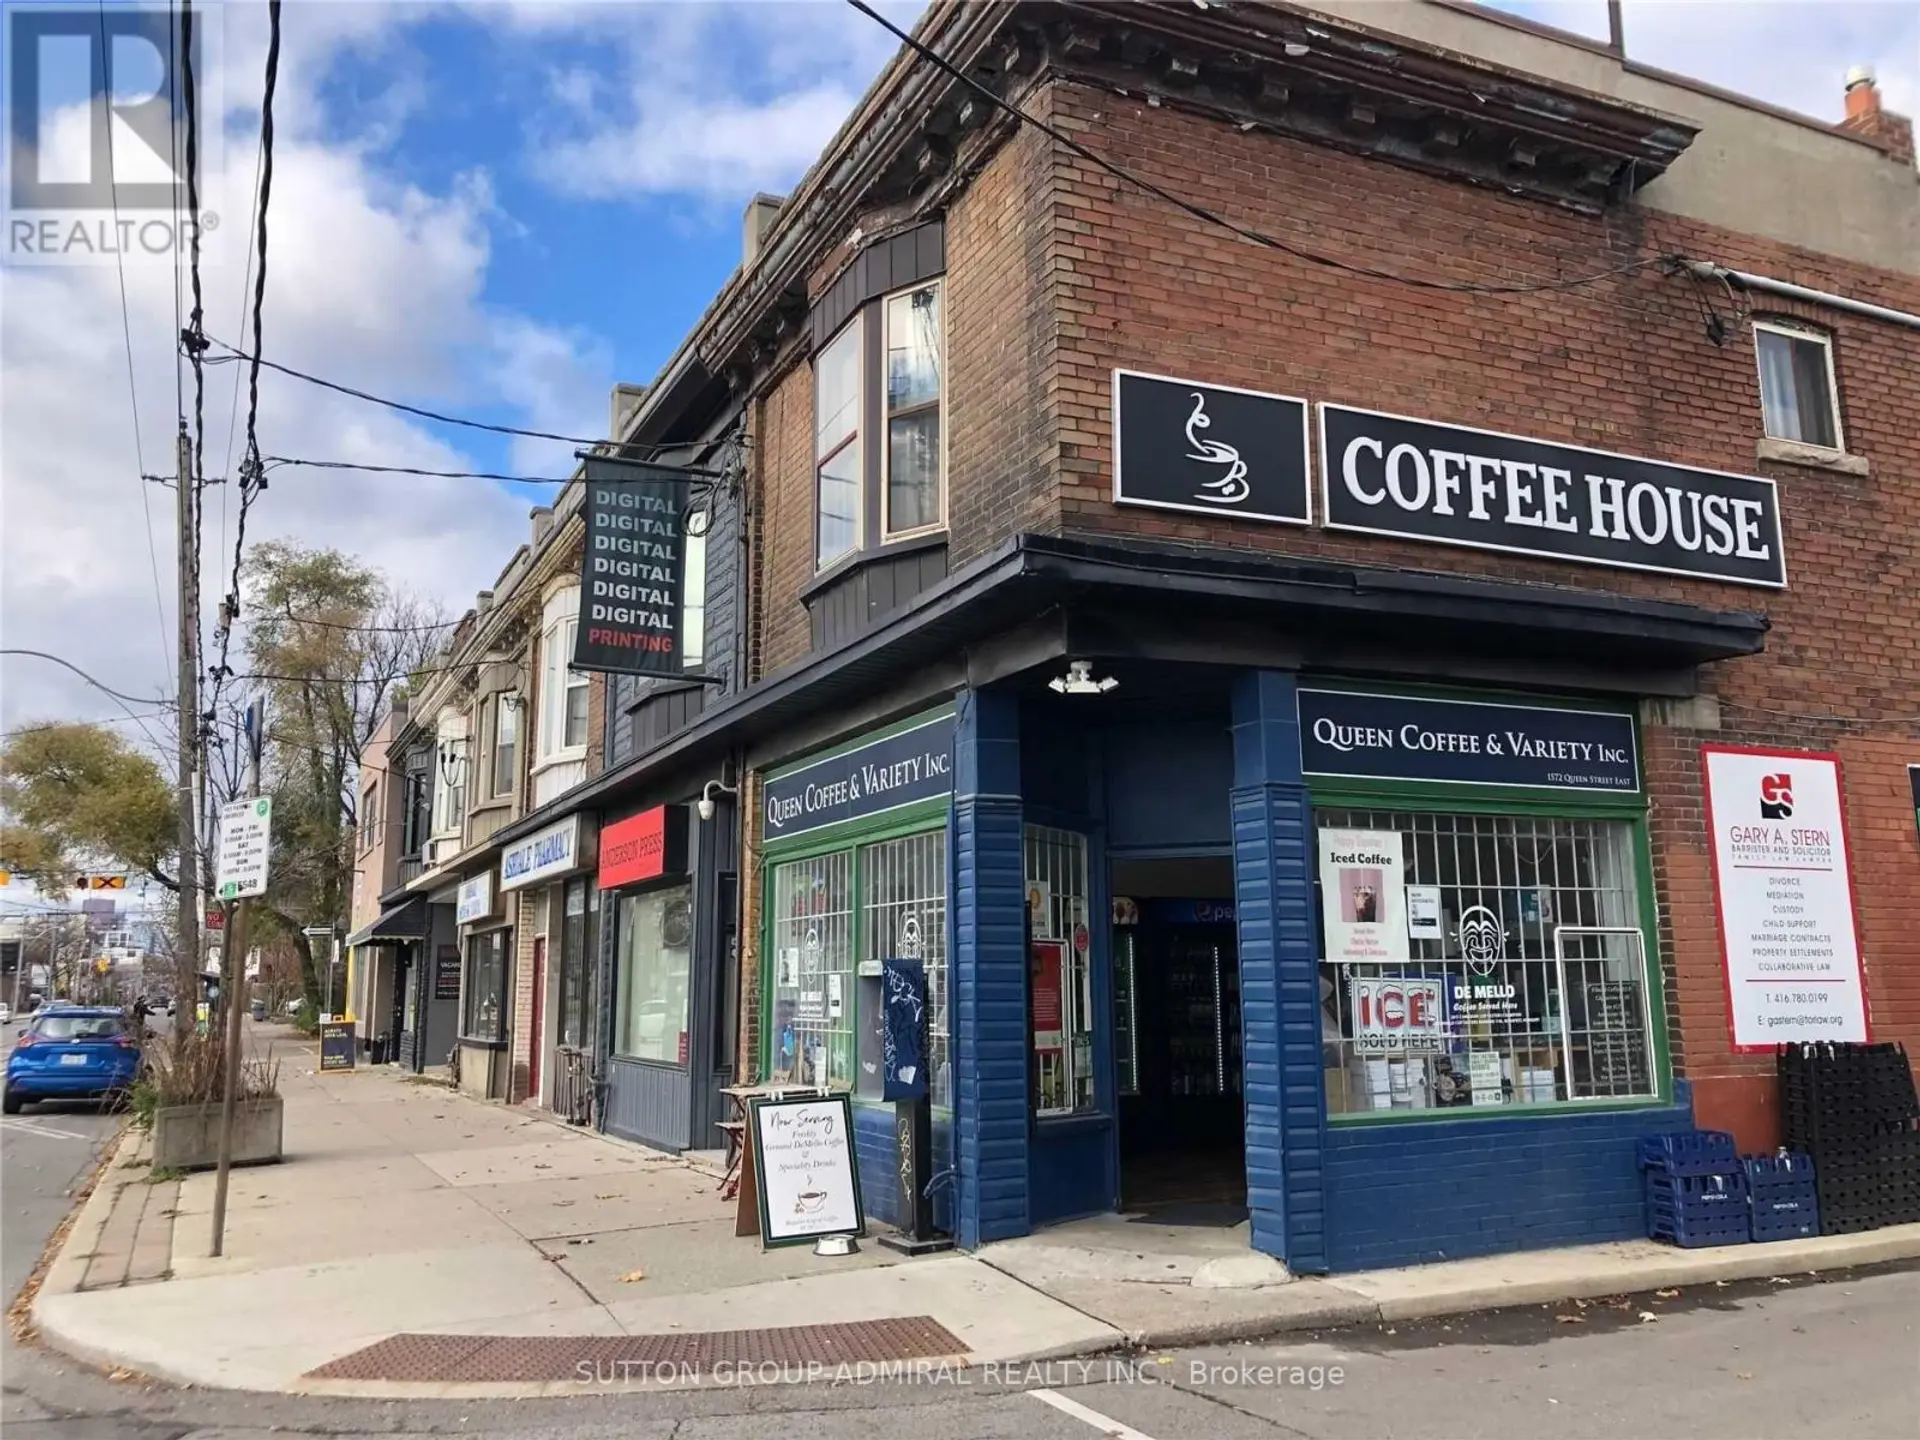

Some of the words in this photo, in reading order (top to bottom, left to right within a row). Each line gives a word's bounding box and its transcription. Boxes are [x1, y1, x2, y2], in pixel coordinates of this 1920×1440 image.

[596, 490, 678, 516] DIGITAL
[1342, 435, 1578, 533] COFFEE
[1584, 474, 1770, 561] HOUSE
[595, 512, 677, 538] DIGITAL
[595, 535, 676, 560] DIGITAL
[594, 558, 675, 583] DIGITAL
[593, 580, 674, 606] DIGITAL
[592, 604, 673, 629] DIGITAL
[589, 628, 673, 653] PRINTING
[1313, 718, 1394, 751] QUEEN
[1400, 724, 1480, 755] COFFEE
[1486, 735, 1504, 756] &
[1505, 731, 1593, 763] VARIETY
[1598, 744, 1629, 764] INC.
[1547, 772, 1564, 783] 1572
[1564, 774, 1587, 786] QUEEN
[1589, 775, 1613, 786] STREET
[1615, 776, 1631, 786] EAST
[767, 795, 803, 828] QUEEN
[805, 780, 848, 813] COFFEE
[849, 773, 860, 800] &
[861, 756, 922, 796] VARIETY
[638, 831, 663, 862] PRESS
[1730, 826, 1769, 845] GARY
[1773, 828, 1788, 845] A.
[1791, 829, 1830, 847] STERN
[1330, 852, 1355, 863] Iced
[1357, 853, 1392, 865] Coffee
[1731, 844, 1770, 854] BARRISTER
[1773, 846, 1790, 855] AND
[1792, 847, 1831, 857] SOLICITOR
[1769, 877, 1800, 886] DIVORCE
[1766, 891, 1804, 900] MEDIATION
[1772, 905, 1804, 914] CUSTODY
[1763, 919, 1784, 928] CHILD
[1787, 920, 1817, 929] SUPPORT
[1751, 934, 1787, 943] MARRIAGE
[1790, 934, 1831, 943] CONTRACTS
[1752, 948, 1787, 957] PROPERTY
[1789, 948, 1833, 957] SETTLEMENTS
[1758, 962, 1814, 971] COLLABORATIVE
[1816, 963, 1830, 971] LAW
[1454, 986, 1472, 999] DE
[1475, 985, 1515, 999] MELLO
[1358, 984, 1437, 1028] ICE
[771, 1111, 793, 1130] Now
[798, 1108, 835, 1134] Serving
